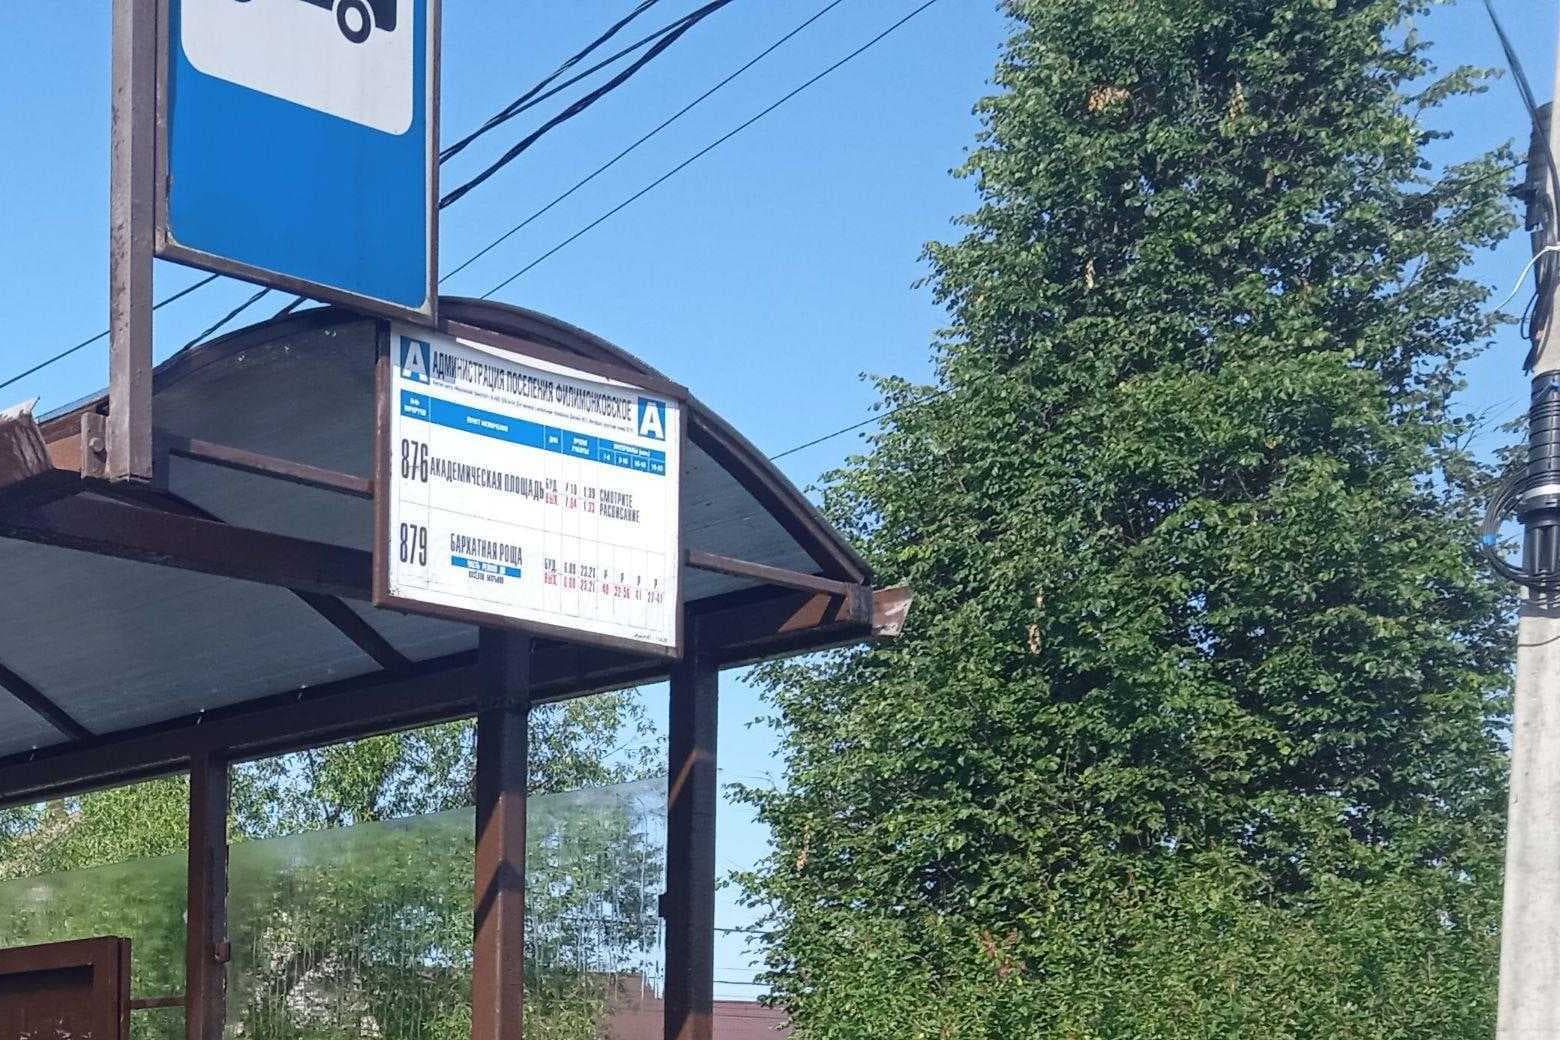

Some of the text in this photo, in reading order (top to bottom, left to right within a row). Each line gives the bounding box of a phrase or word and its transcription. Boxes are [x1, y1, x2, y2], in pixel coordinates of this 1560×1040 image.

[433, 351, 505, 391] АДМИНИСТРАЦИЯ
[507, 371, 554, 404] ПОСЕЛЕНИЯ
[556, 384, 632, 421] ФИЛИМОНКОВСКОЕ
[401, 439, 429, 483] 876
[430, 456, 545, 502] АКАДЕМИЧЕСКАЯ ПЛОЩАДЬ
[400, 522, 428, 567] 879
[450, 533, 498, 560] БАРХАТНАЯ
[499, 543, 523, 566] РОЩА
